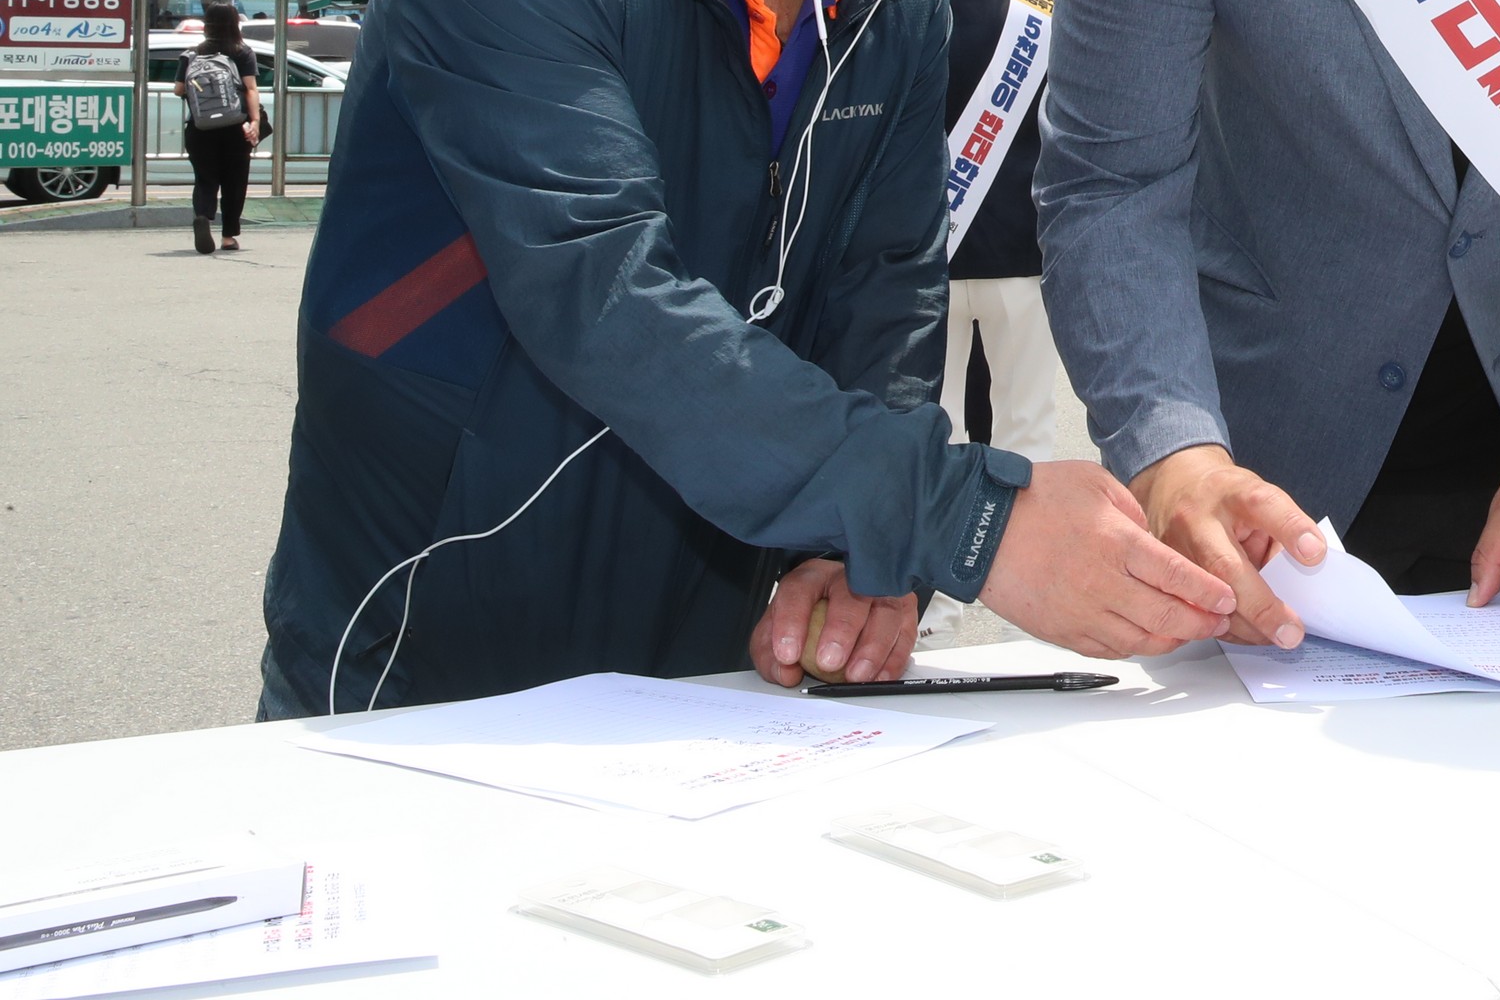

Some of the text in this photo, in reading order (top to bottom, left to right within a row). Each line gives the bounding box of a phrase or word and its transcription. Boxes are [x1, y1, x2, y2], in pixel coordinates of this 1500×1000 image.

[3, 54, 37, 64] 목포시
[95, 57, 121, 66] 진도군
[991, 15, 1042, 113] 5천만이
[0, 95, 125, 134] 포대형택시
[8, 141, 124, 159] 010-4905-9895
[964, 501, 996, 568] BLACKYAK
